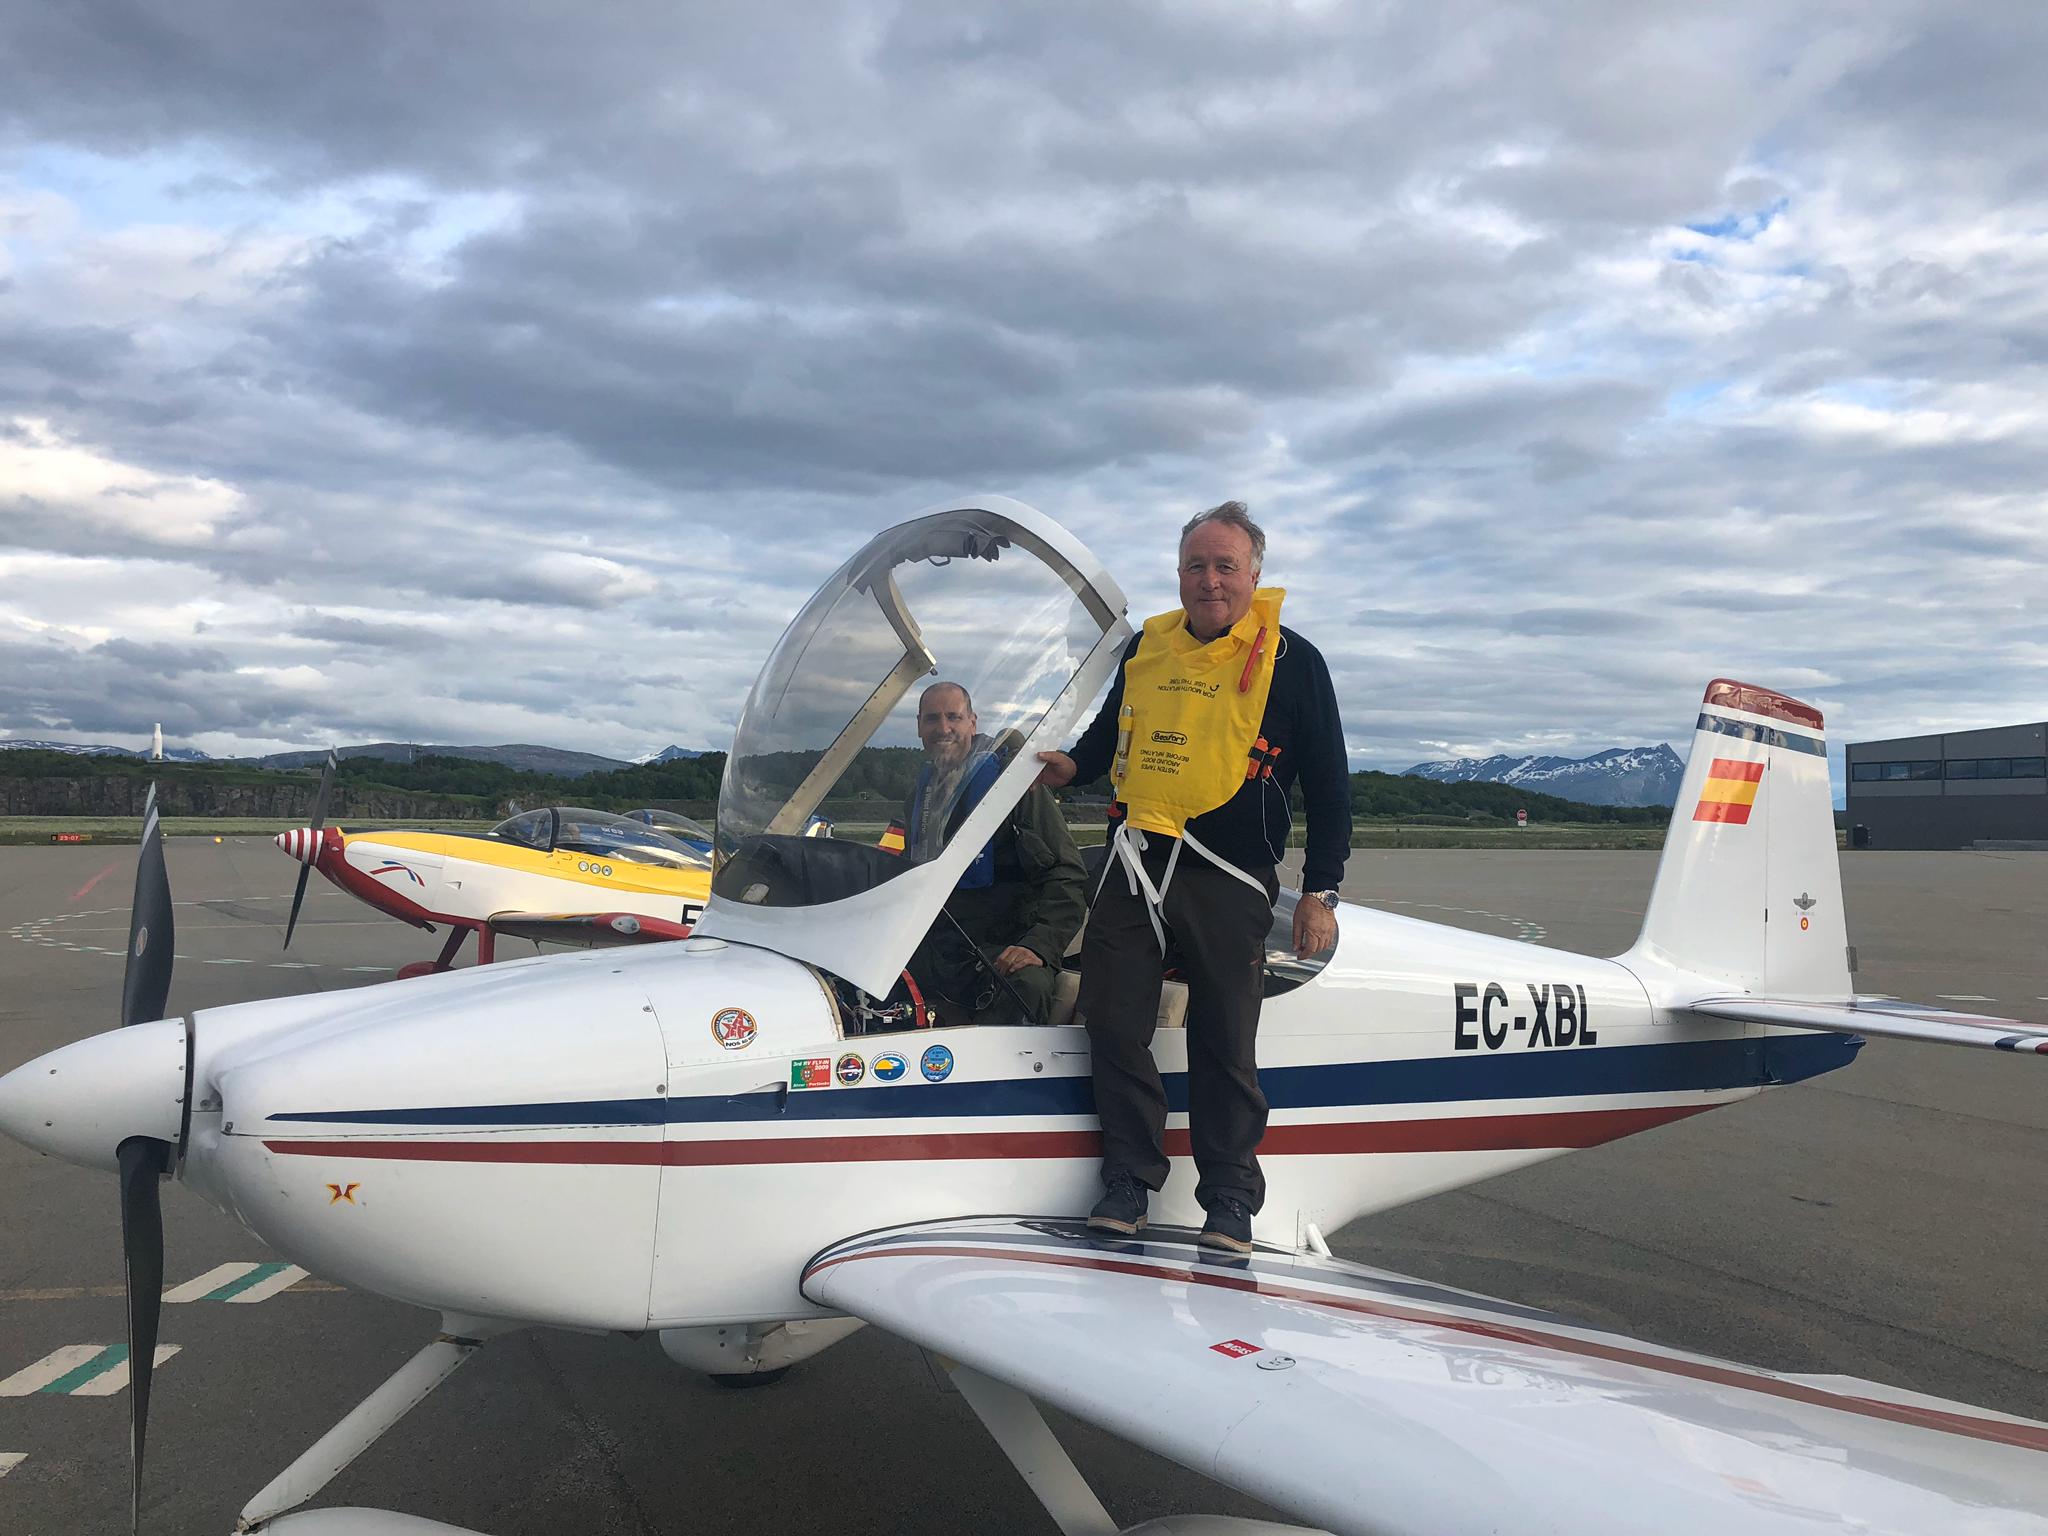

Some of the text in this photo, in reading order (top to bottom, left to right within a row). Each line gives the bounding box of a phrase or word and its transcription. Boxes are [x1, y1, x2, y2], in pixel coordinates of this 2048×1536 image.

[1195, 680, 1207, 688] USE
[1181, 686, 1202, 694] MOUTH
[1154, 733, 1184, 743] Beaufort
[1140, 749, 1189, 762] BEFORE INFLATING
[1157, 758, 1180, 767] AROUND
[1158, 767, 1179, 775] FASTEN
[1454, 982, 1598, 1050] EC-XBL
[1220, 1343, 1252, 1354] AVGAS
